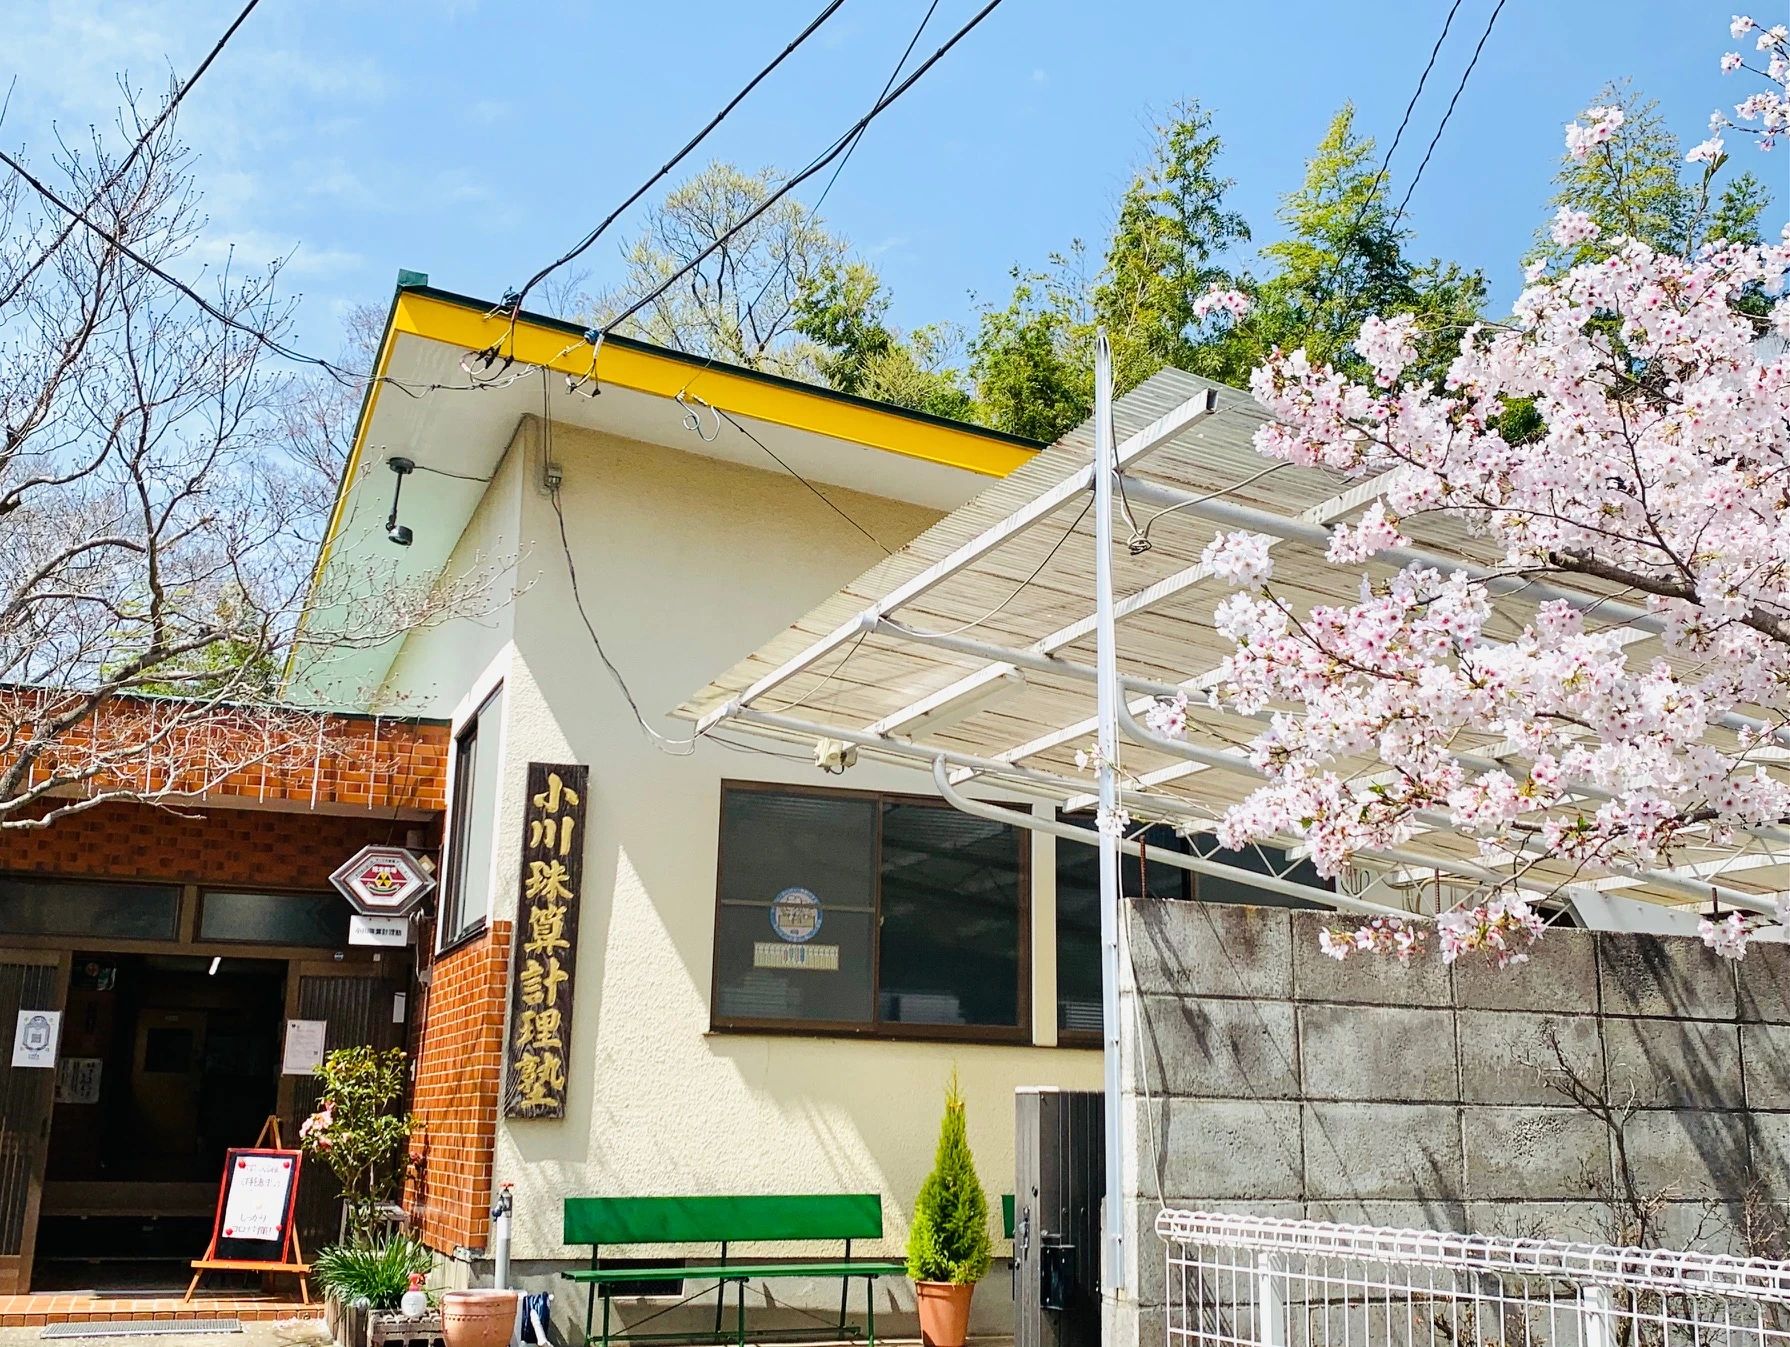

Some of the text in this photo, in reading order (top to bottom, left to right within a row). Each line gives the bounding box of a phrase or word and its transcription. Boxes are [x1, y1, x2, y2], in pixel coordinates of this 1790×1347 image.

[515, 772, 579, 1109] 小川珠算計理塾
